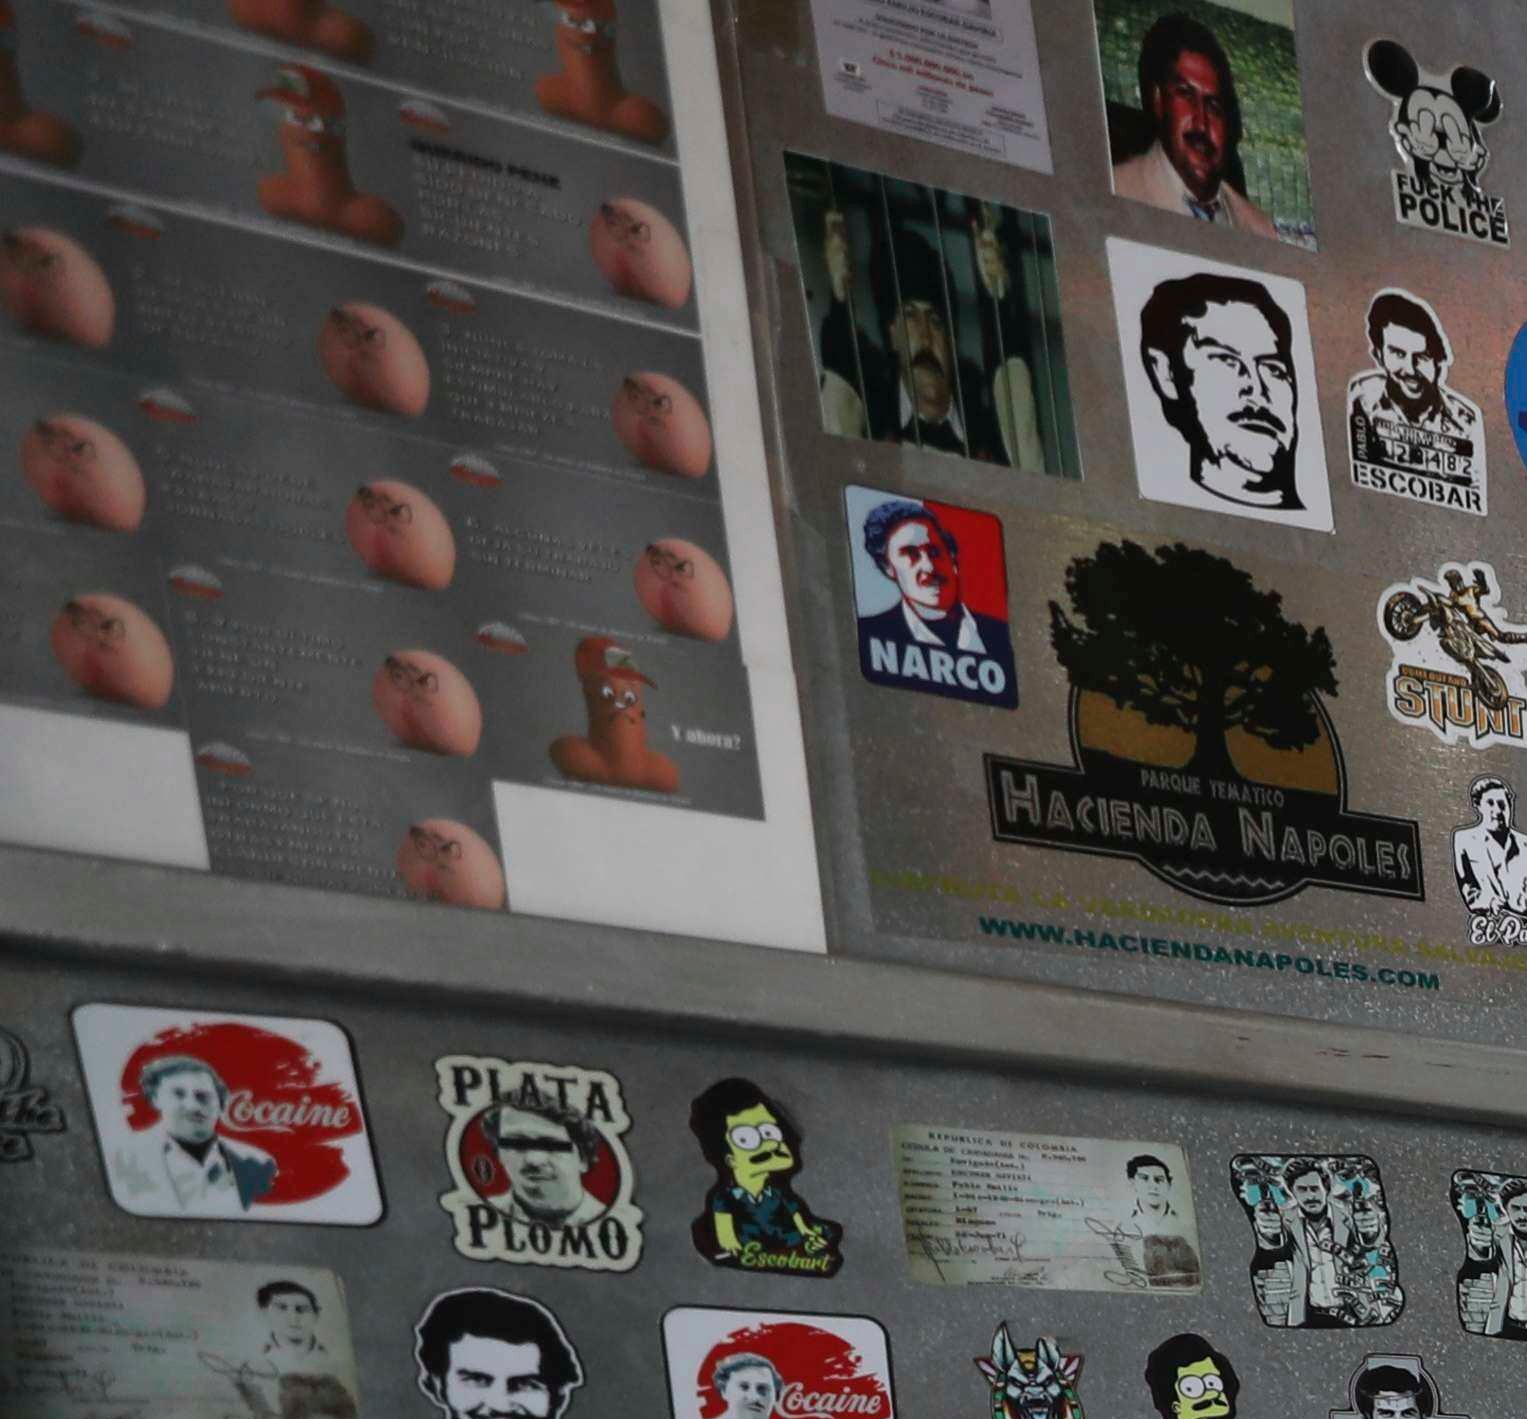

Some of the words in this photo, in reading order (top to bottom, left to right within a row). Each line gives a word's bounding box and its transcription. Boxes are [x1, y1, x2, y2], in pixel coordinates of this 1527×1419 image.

[1396, 173, 1456, 202] FUCK
[1400, 194, 1508, 244] POLICE
[1353, 463, 1482, 512] ESCOBAR
[870, 641, 1006, 695] NARCO
[1394, 678, 1526, 738] STUNT
[1001, 771, 1216, 850] HACIENDA
[1239, 809, 1413, 881] NAPOLES
[978, 916, 1441, 991] WWW.HACIENDANAPOLES.COM
[220, 1091, 352, 1131] Cocaine
[452, 1065, 612, 1124] PLATA
[468, 1205, 629, 1259] PLOMO
[740, 1242, 837, 1275] Escobart
[776, 1382, 882, 1418] Cocaine
